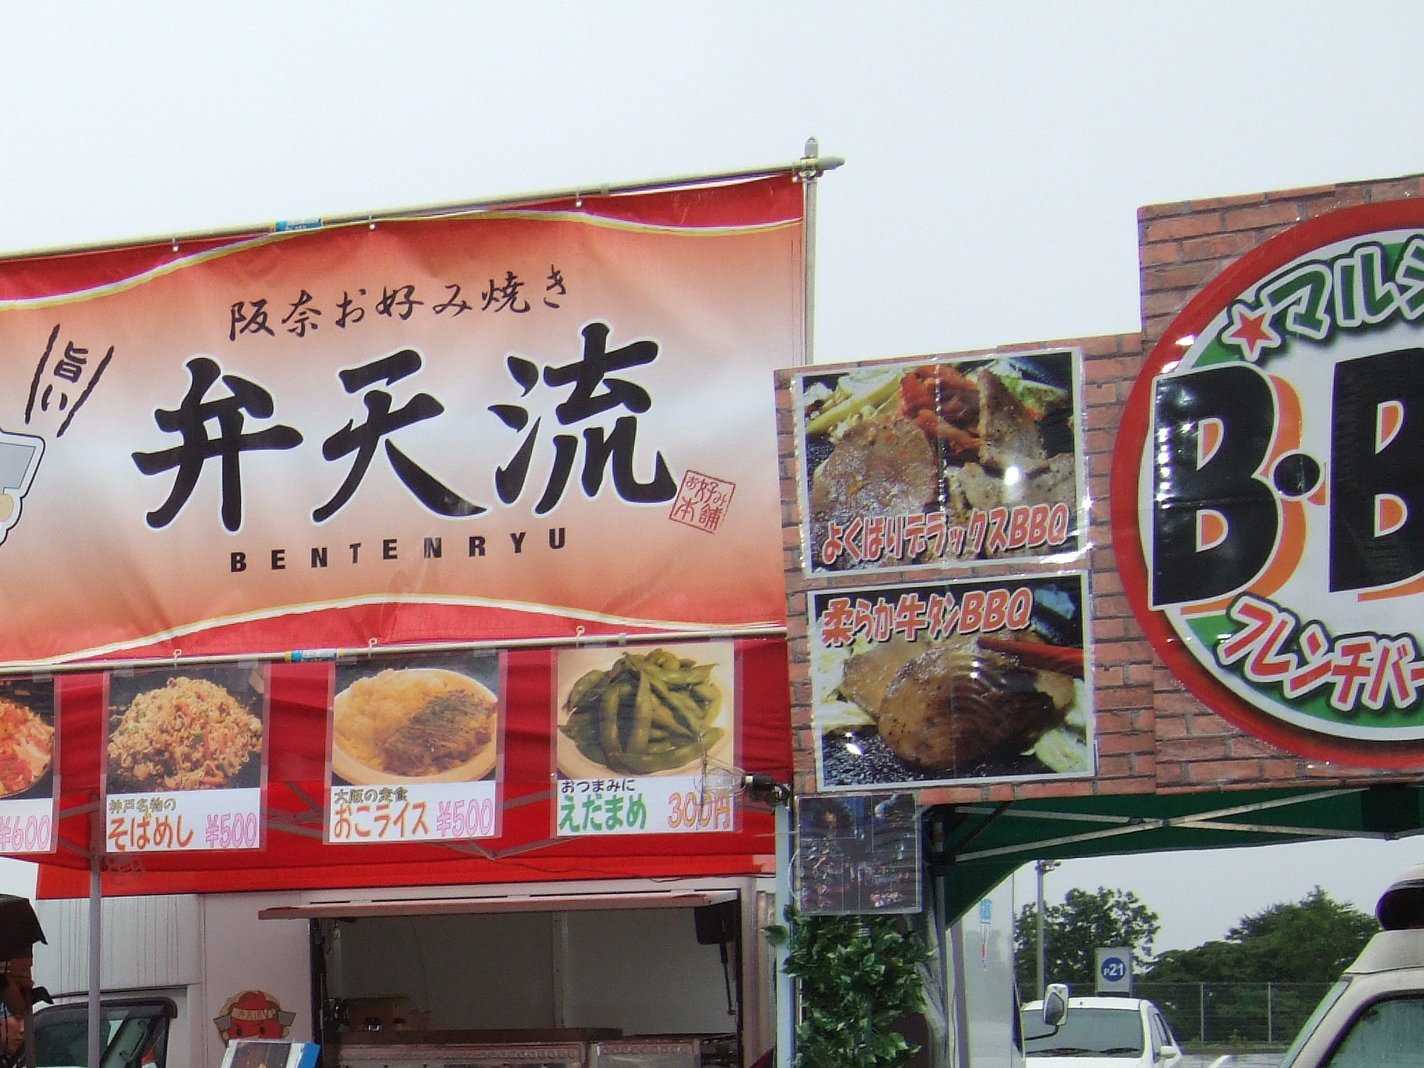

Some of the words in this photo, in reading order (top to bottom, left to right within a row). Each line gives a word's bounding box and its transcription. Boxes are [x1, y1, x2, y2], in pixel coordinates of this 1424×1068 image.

[229, 265, 567, 340] 阪奈お好み焼き
[131, 322, 676, 532] 弁天流
[231, 528, 567, 573] BENTENRYU
[822, 587, 1033, 648] 柔らか牛タンBBQ
[109, 797, 176, 814] 神戸名物の
[334, 787, 408, 804] 大阪の定食
[561, 778, 635, 793] おつまみに
[108, 813, 194, 851] そばめし
[206, 812, 257, 848] ¥500
[334, 802, 430, 839] おこライス
[436, 798, 494, 838] ¥500
[559, 793, 646, 833] えだまめ
[668, 791, 731, 829] 300円
